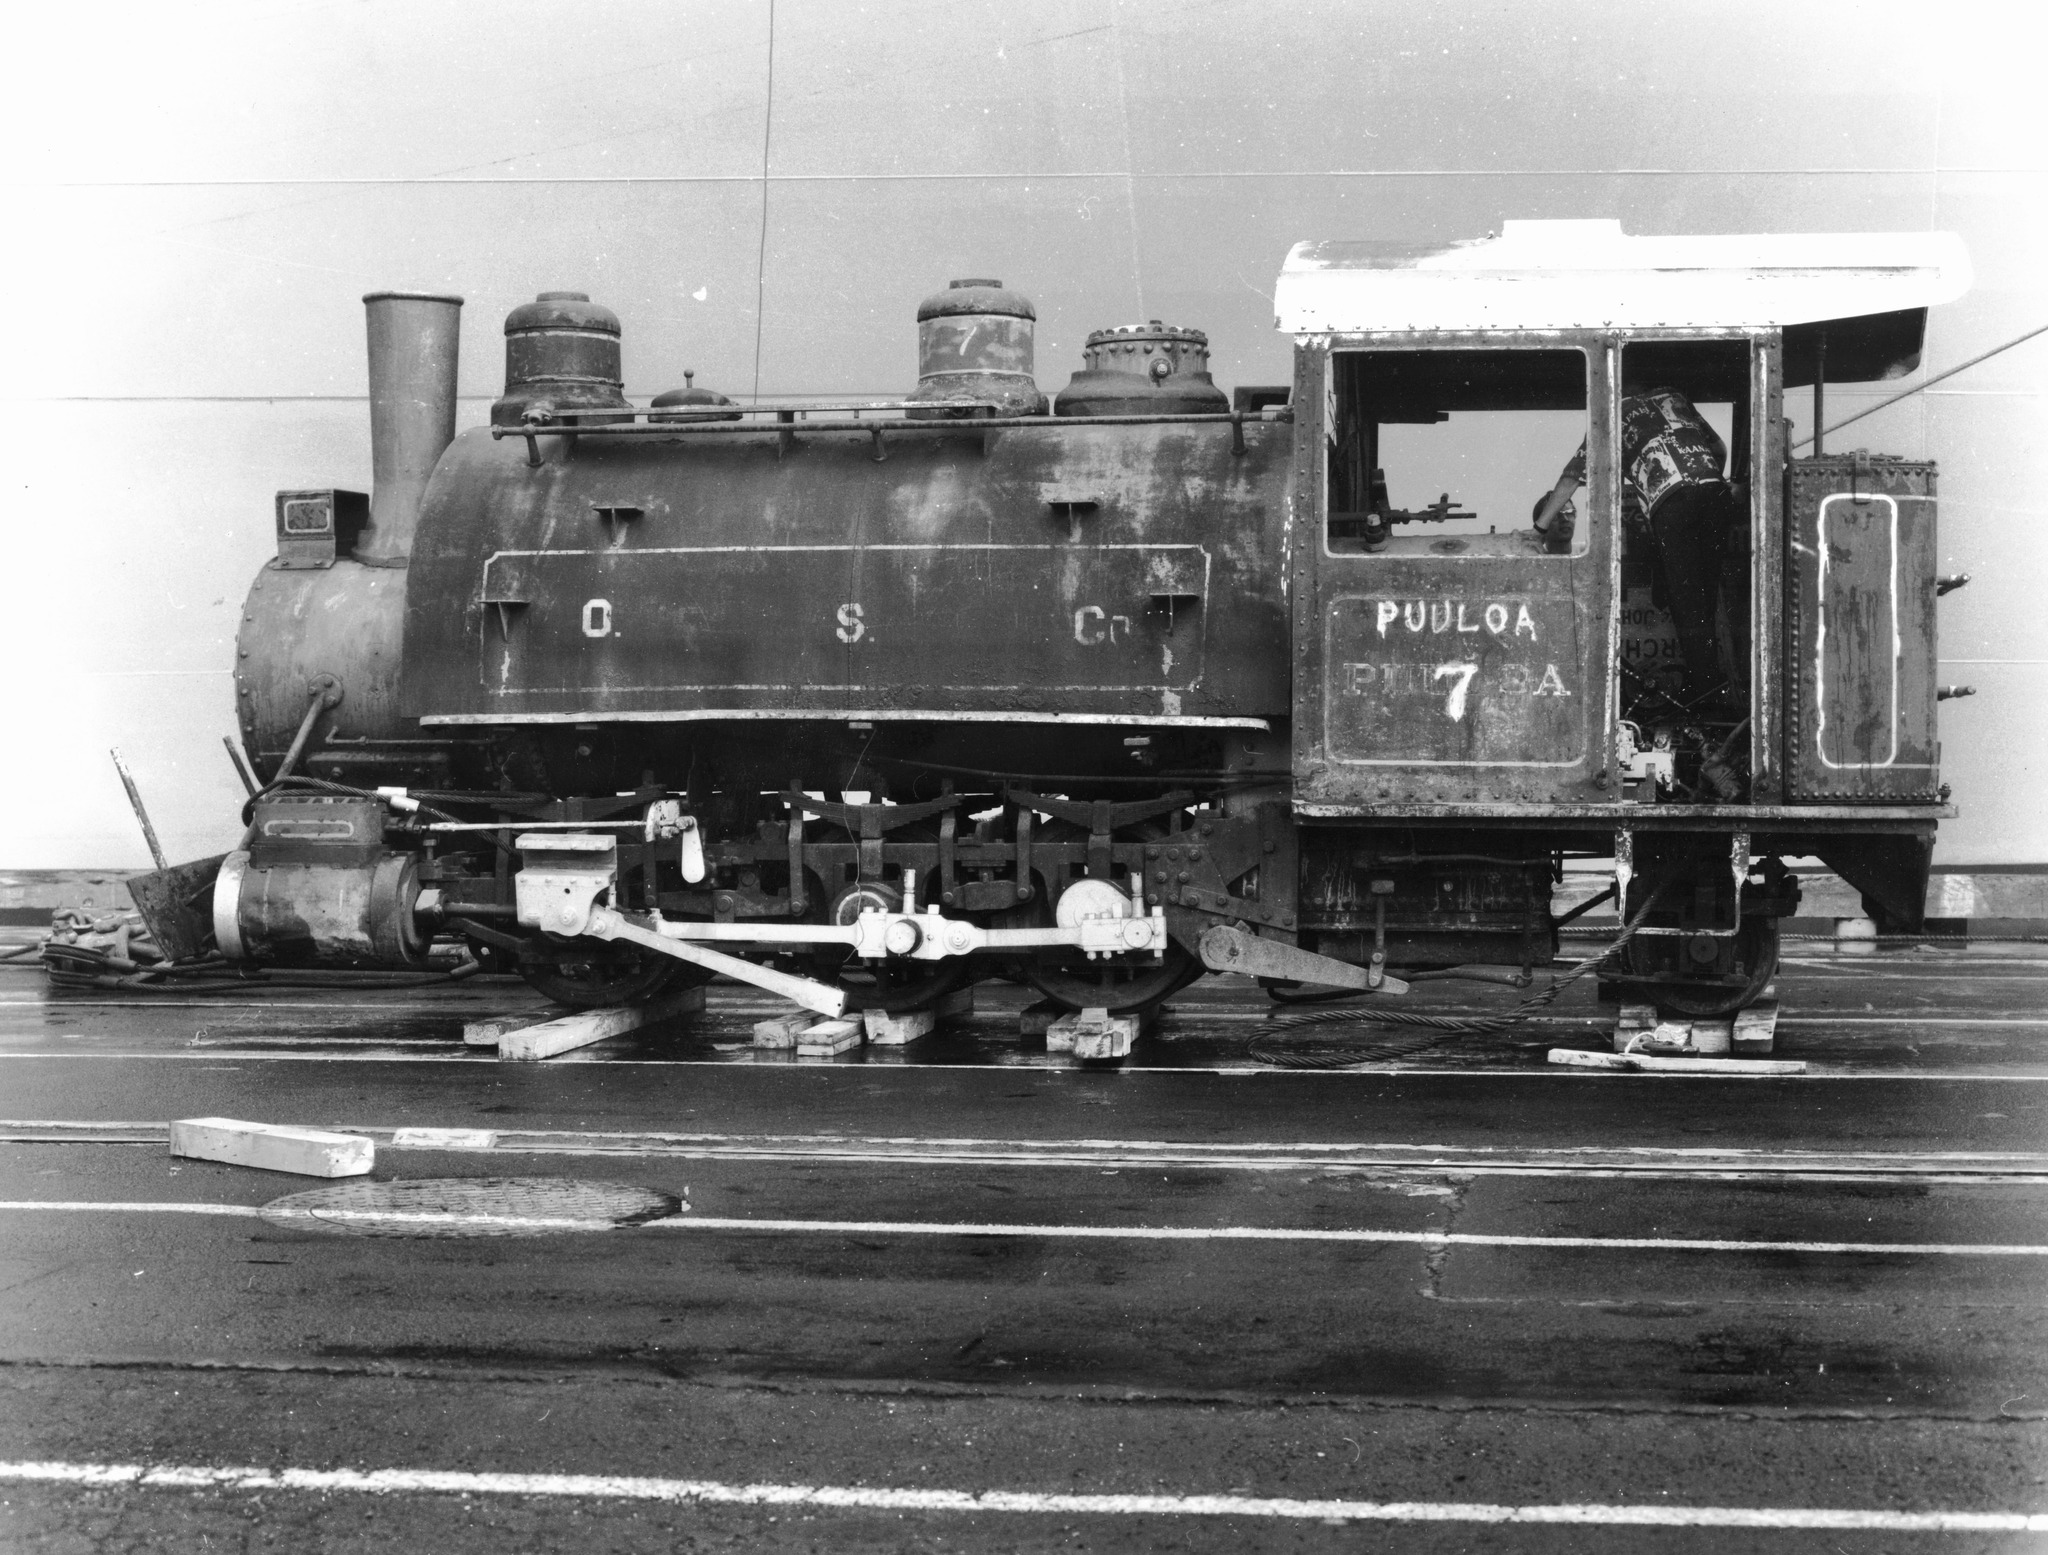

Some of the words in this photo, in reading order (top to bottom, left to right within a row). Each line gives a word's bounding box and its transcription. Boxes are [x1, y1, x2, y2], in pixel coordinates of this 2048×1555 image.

[957, 326, 978, 356] 7
[1377, 600, 1537, 641] PUULOA
[1434, 661, 1479, 722] 7
